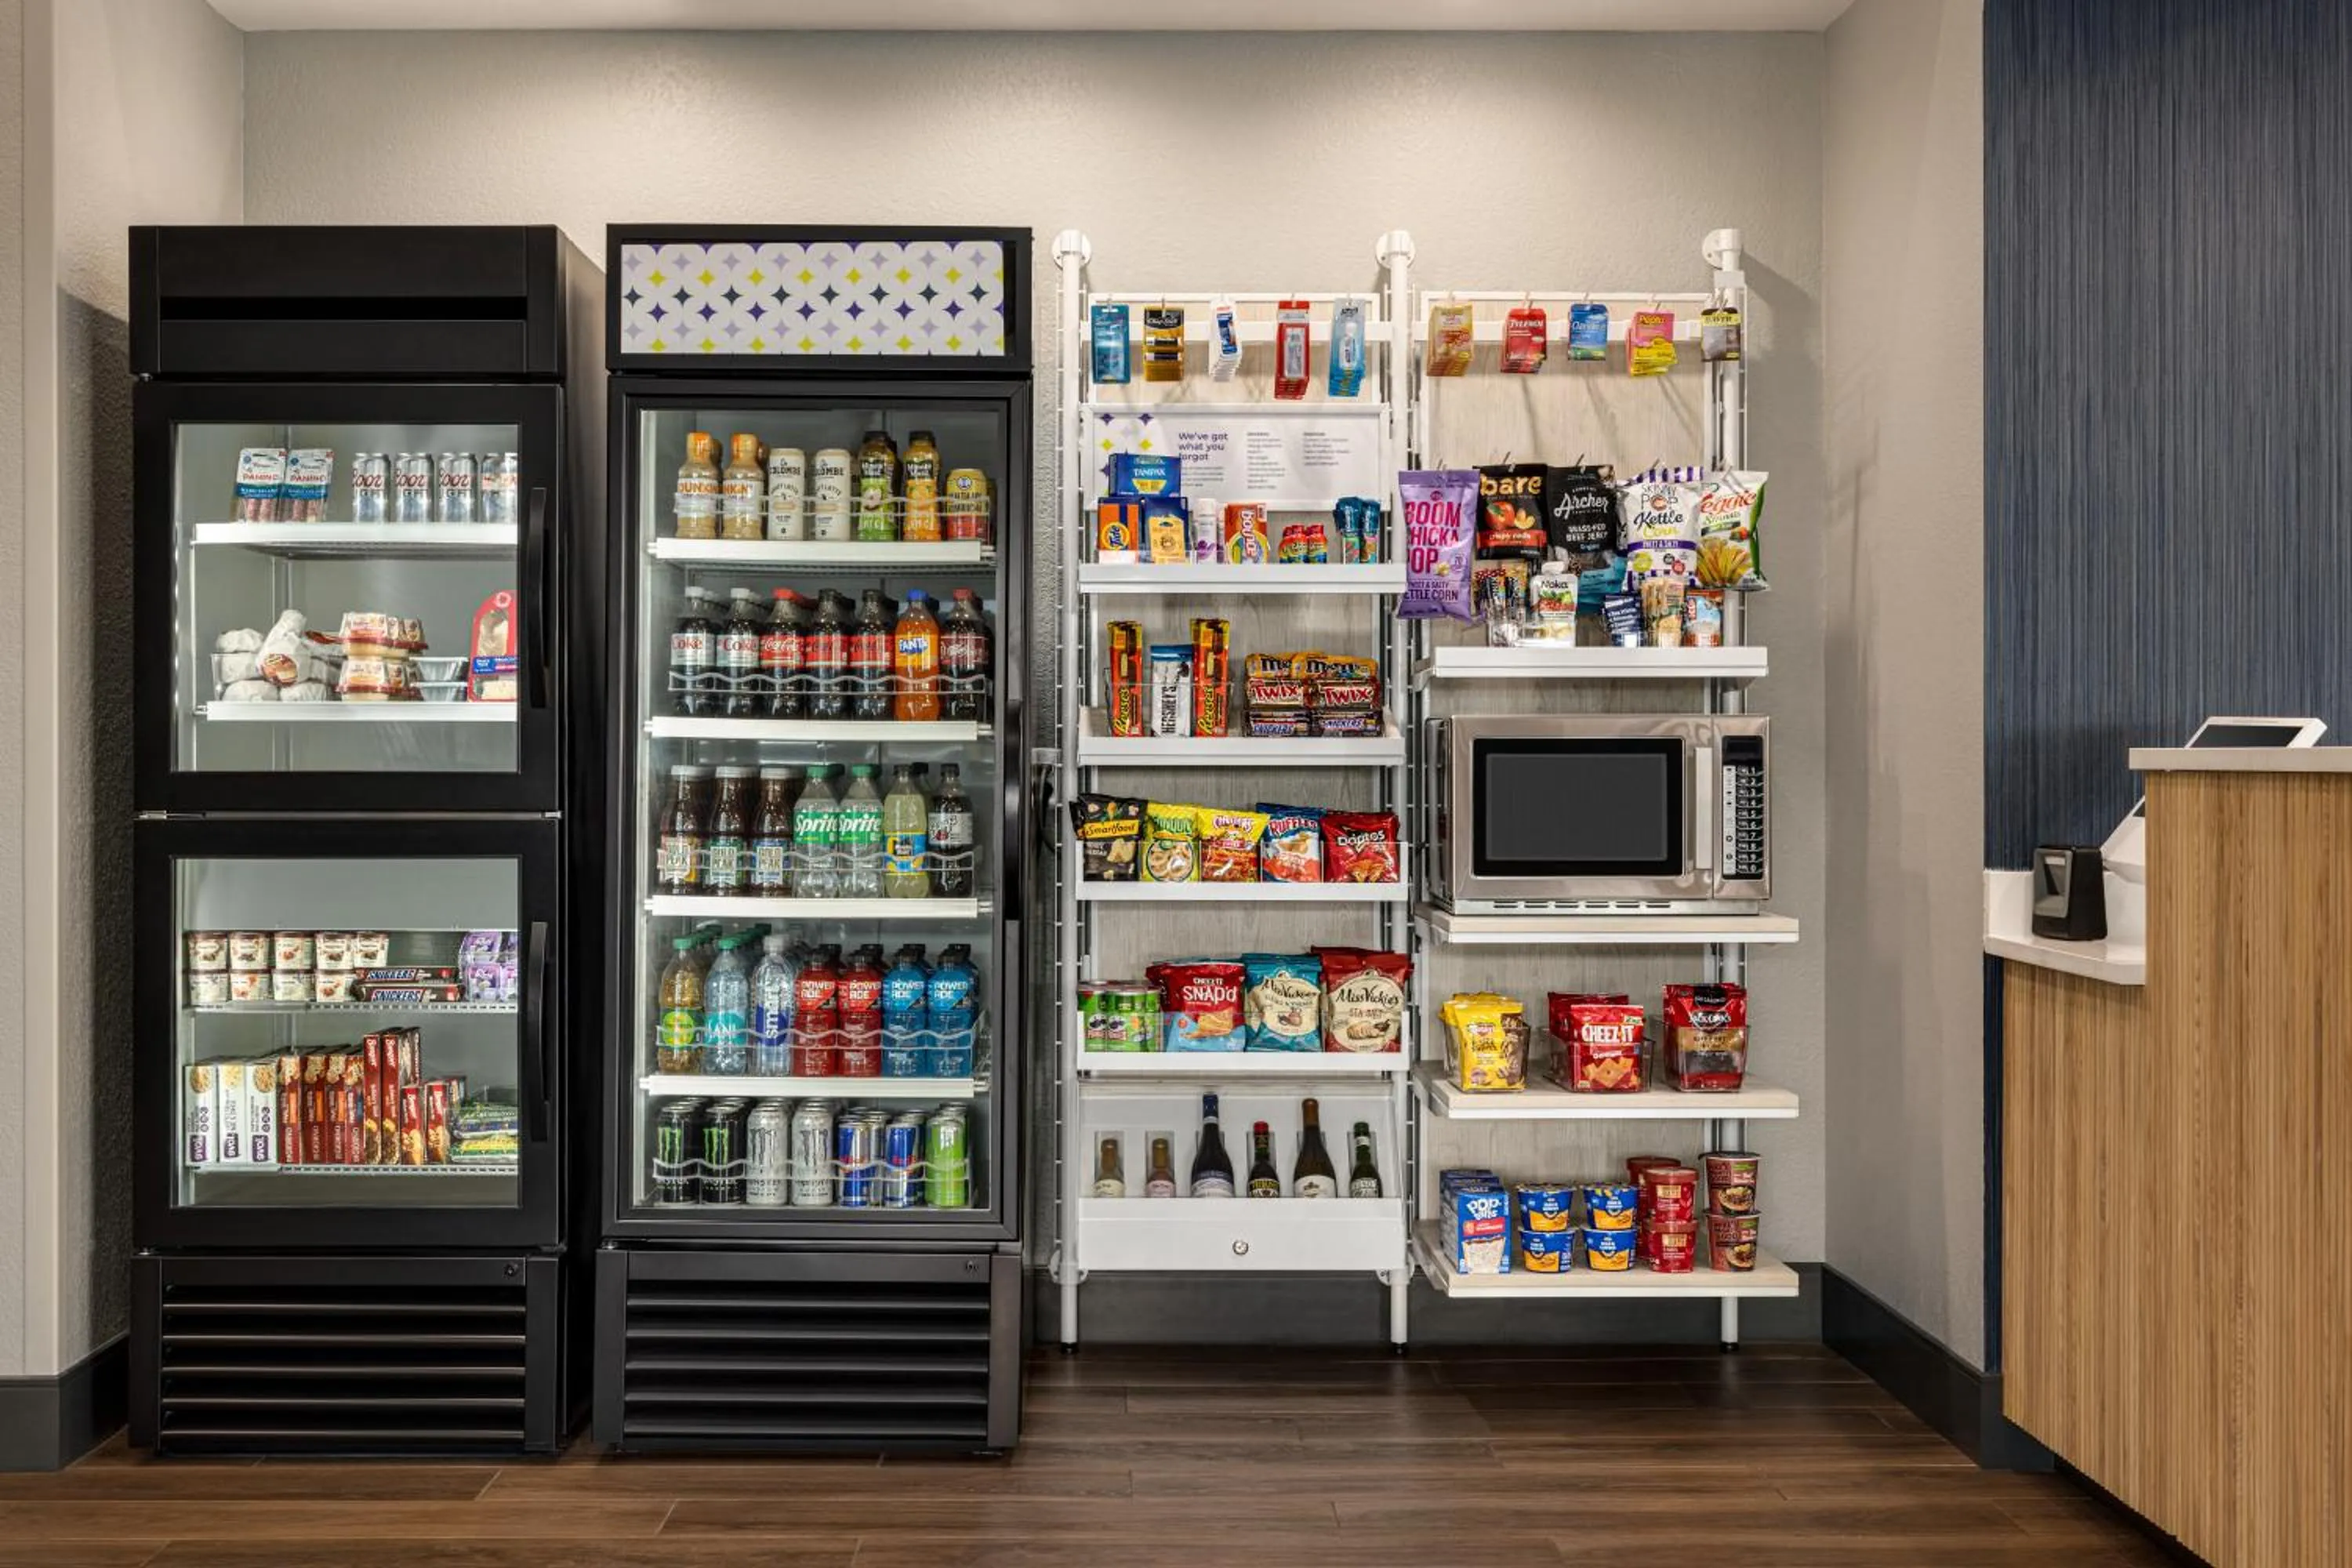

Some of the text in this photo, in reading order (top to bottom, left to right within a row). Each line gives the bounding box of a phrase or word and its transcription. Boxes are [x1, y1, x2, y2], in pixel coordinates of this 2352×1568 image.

[1178, 432, 1229, 441] We've got
[1480, 474, 1541, 495] bare
[1554, 492, 1610, 520] Archer
[1633, 511, 1683, 530] Kettle
[1406, 527, 1459, 546] HICKA
[1407, 550, 1439, 574] OP
[1432, 590, 1458, 600] CORN
[1254, 684, 1298, 702] TWIX
[1323, 688, 1370, 704] TWIX
[1084, 823, 1134, 836] Smartfood
[1337, 830, 1385, 846] Doritos
